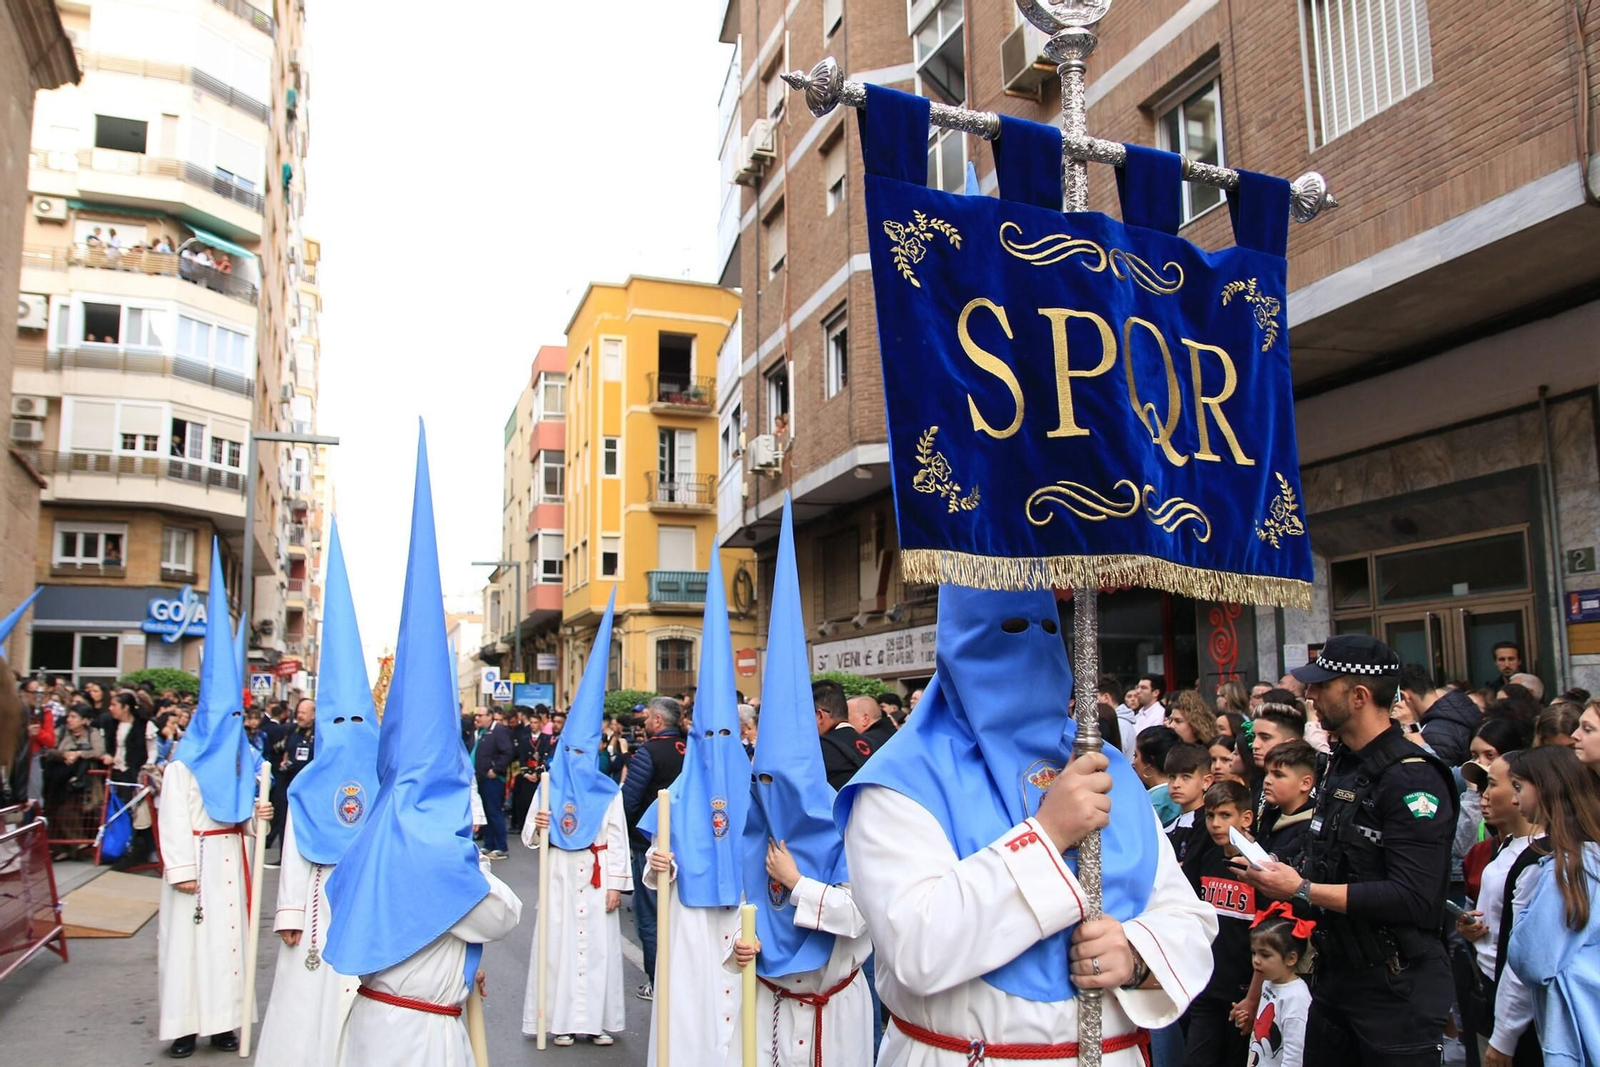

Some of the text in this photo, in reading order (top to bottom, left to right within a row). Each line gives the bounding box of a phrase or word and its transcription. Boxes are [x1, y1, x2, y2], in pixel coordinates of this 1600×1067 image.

[957, 297, 1255, 467] SPQR
[1573, 550, 1587, 571] 2
[1208, 881, 1239, 891] CHICAGO
[1200, 885, 1248, 912] BULLS
